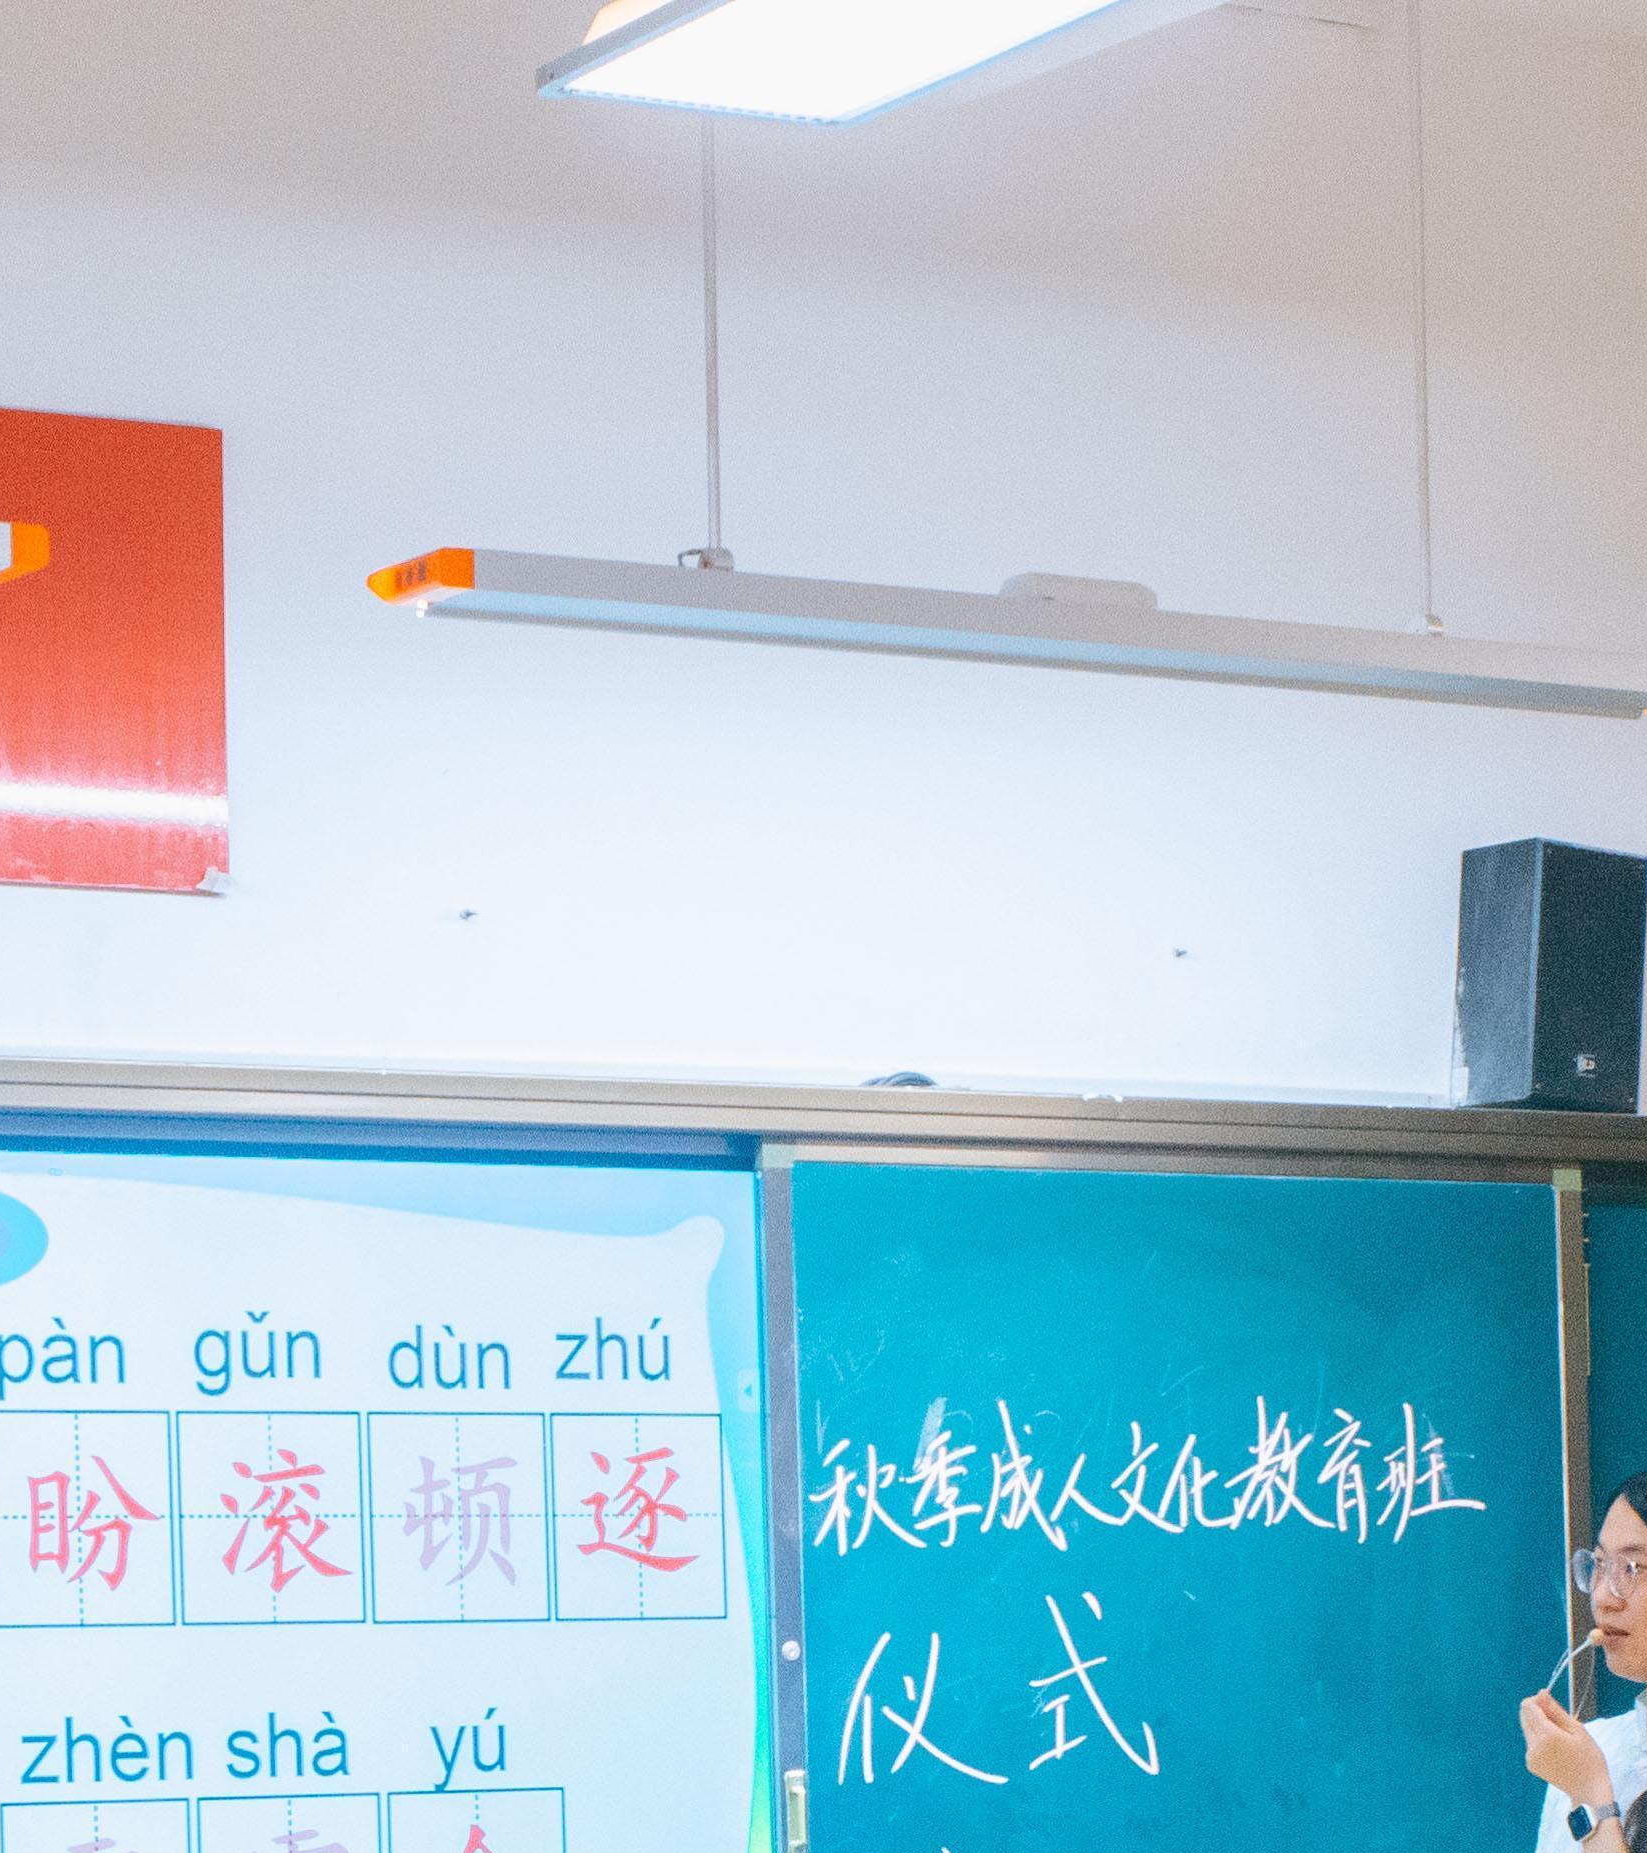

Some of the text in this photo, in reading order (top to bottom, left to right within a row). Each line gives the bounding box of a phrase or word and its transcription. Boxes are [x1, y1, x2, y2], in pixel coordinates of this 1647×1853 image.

[194, 1311, 322, 1396] gǔn
[388, 1324, 512, 1390] dùn
[555, 1317, 672, 1382] zhú
[27, 1455, 162, 1591] 盼
[220, 1448, 353, 1593] 滚
[402, 1456, 518, 1588] 顿
[576, 1446, 700, 1572] 逐
[809, 1396, 1486, 1556] 秋季成人文化教育班
[20, 1716, 194, 1784] zhèn
[225, 1712, 350, 1778] shà
[430, 1708, 508, 1793] yú
[838, 1591, 1160, 1785] 仪式
